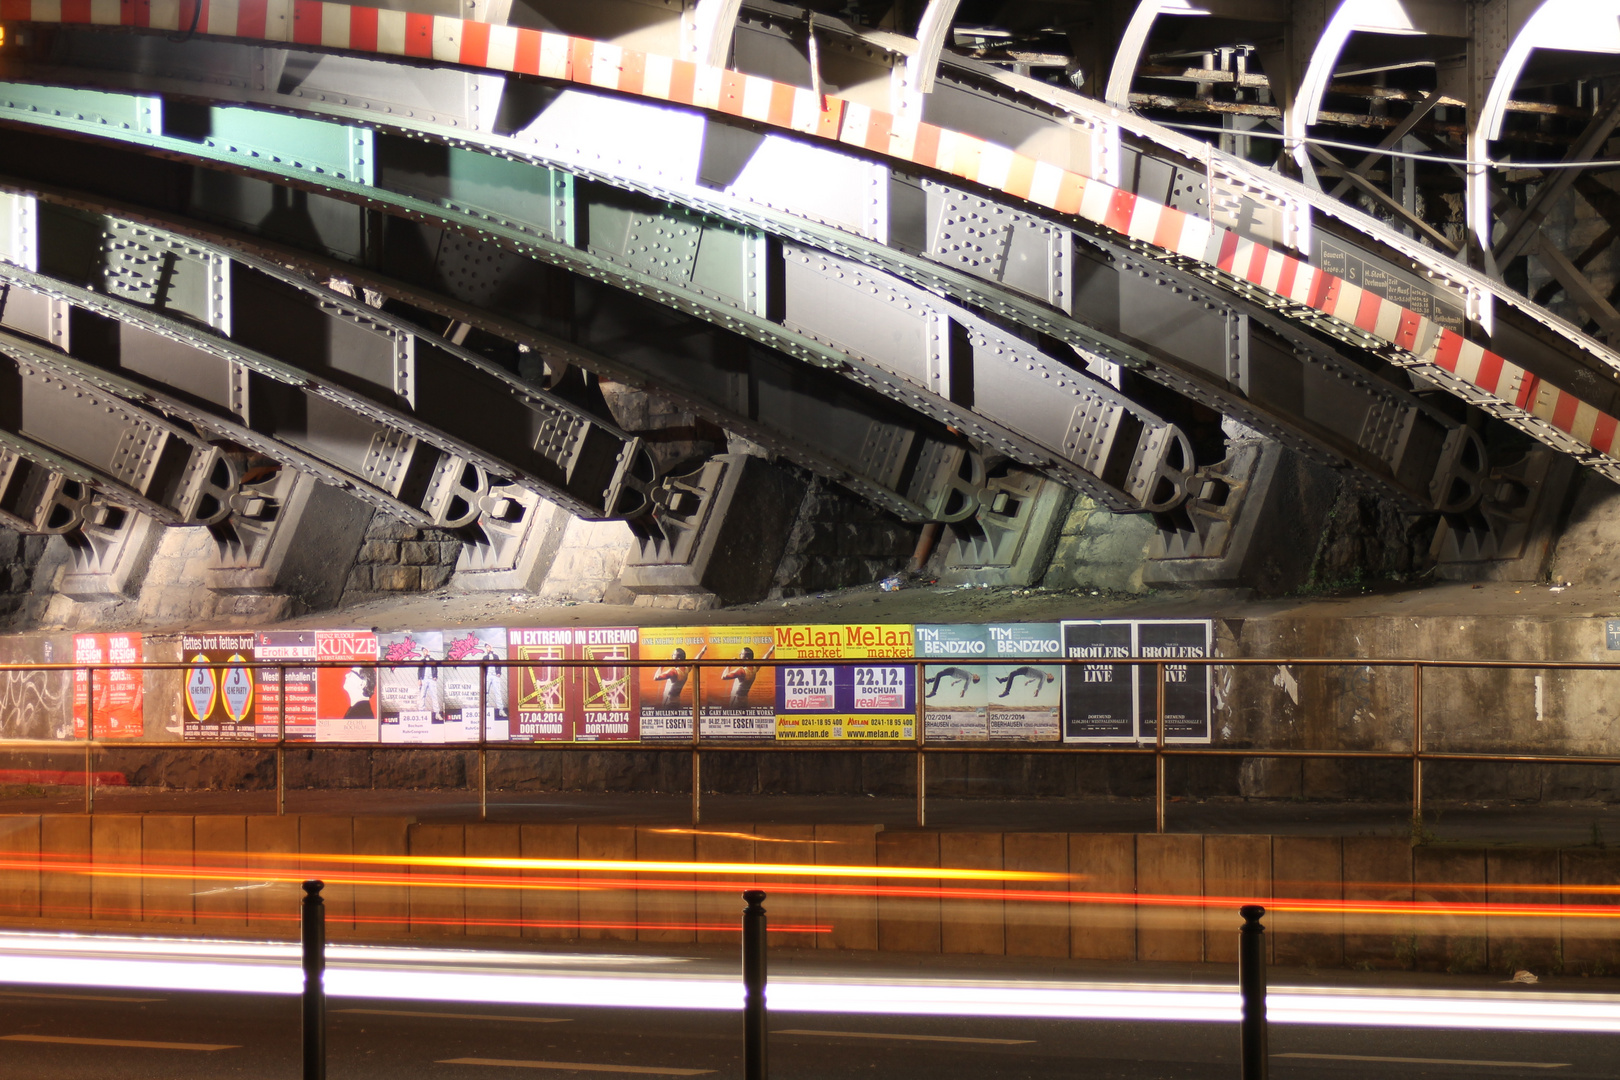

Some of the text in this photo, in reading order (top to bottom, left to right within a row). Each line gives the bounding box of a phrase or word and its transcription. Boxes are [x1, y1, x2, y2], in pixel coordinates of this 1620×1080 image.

[1349, 267, 1356, 279] S
[510, 630, 572, 645] IN EXTREMO
[575, 629, 637, 644] IN EXTREMO
[776, 627, 842, 647] Melan
[846, 627, 912, 646] Melan
[917, 628, 939, 640] TIM
[989, 628, 1012, 640] TIM
[76, 638, 95, 649] YARD
[110, 637, 129, 648] YARD
[183, 636, 217, 650] fettes brot
[219, 636, 255, 650] fettes brot
[317, 638, 377, 654] KUNZE
[685, 637, 705, 646] QUEEN
[753, 636, 773, 645] QUEEN
[262, 648, 289, 656] Erotik
[292, 648, 299, 656] &
[867, 646, 912, 658] market
[925, 641, 985, 653] BENDZKO
[997, 640, 1060, 653] BENDZKO
[1141, 646, 1204, 658] BROILERS
[76, 649, 101, 660] DESIGN
[110, 648, 135, 660] DESIGN
[797, 647, 842, 658] market
[1068, 647, 1129, 658] BROILERS
[786, 669, 833, 687] 22.12.
[856, 669, 903, 686] 22.12.
[1083, 671, 1113, 682] LIVE
[1165, 671, 1187, 682] IVE
[519, 713, 563, 722] 17.04.2014
[584, 713, 629, 722] 17.04.2014
[733, 718, 754, 728] ESSEN
[520, 724, 563, 734] DORTMUND
[585, 724, 628, 734] DORTMUND
[665, 718, 686, 729] ESSEN
[778, 730, 829, 738] www.melan.de
[847, 729, 899, 738] www.melan.de
